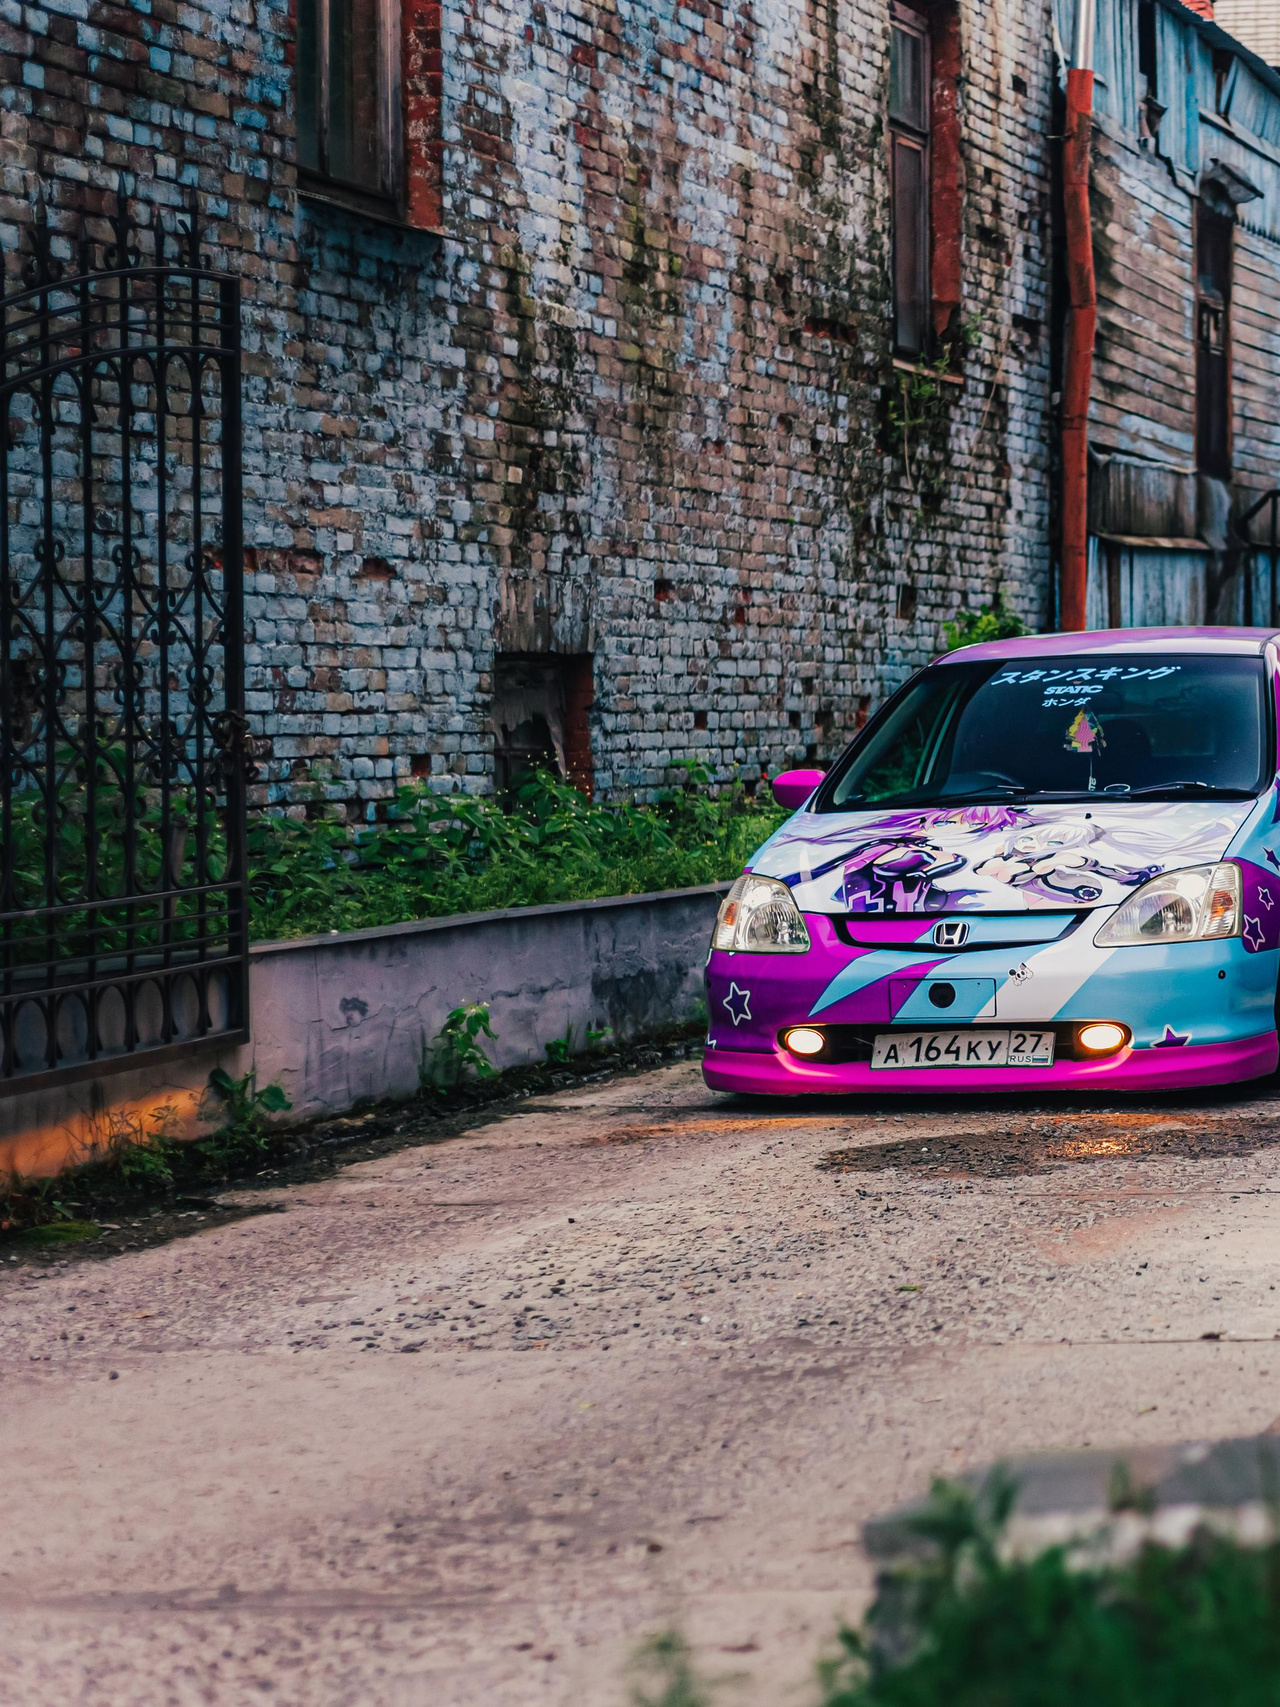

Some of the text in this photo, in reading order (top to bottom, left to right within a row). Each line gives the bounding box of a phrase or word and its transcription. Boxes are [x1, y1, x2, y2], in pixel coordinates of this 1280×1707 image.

[991, 667, 1181, 686] スタンスキング
[1044, 685, 1104, 695] STATIC
[1042, 697, 1091, 708] ホンダ
[1012, 1034, 1042, 1054] 27
[1009, 1055, 1032, 1063] RUS
